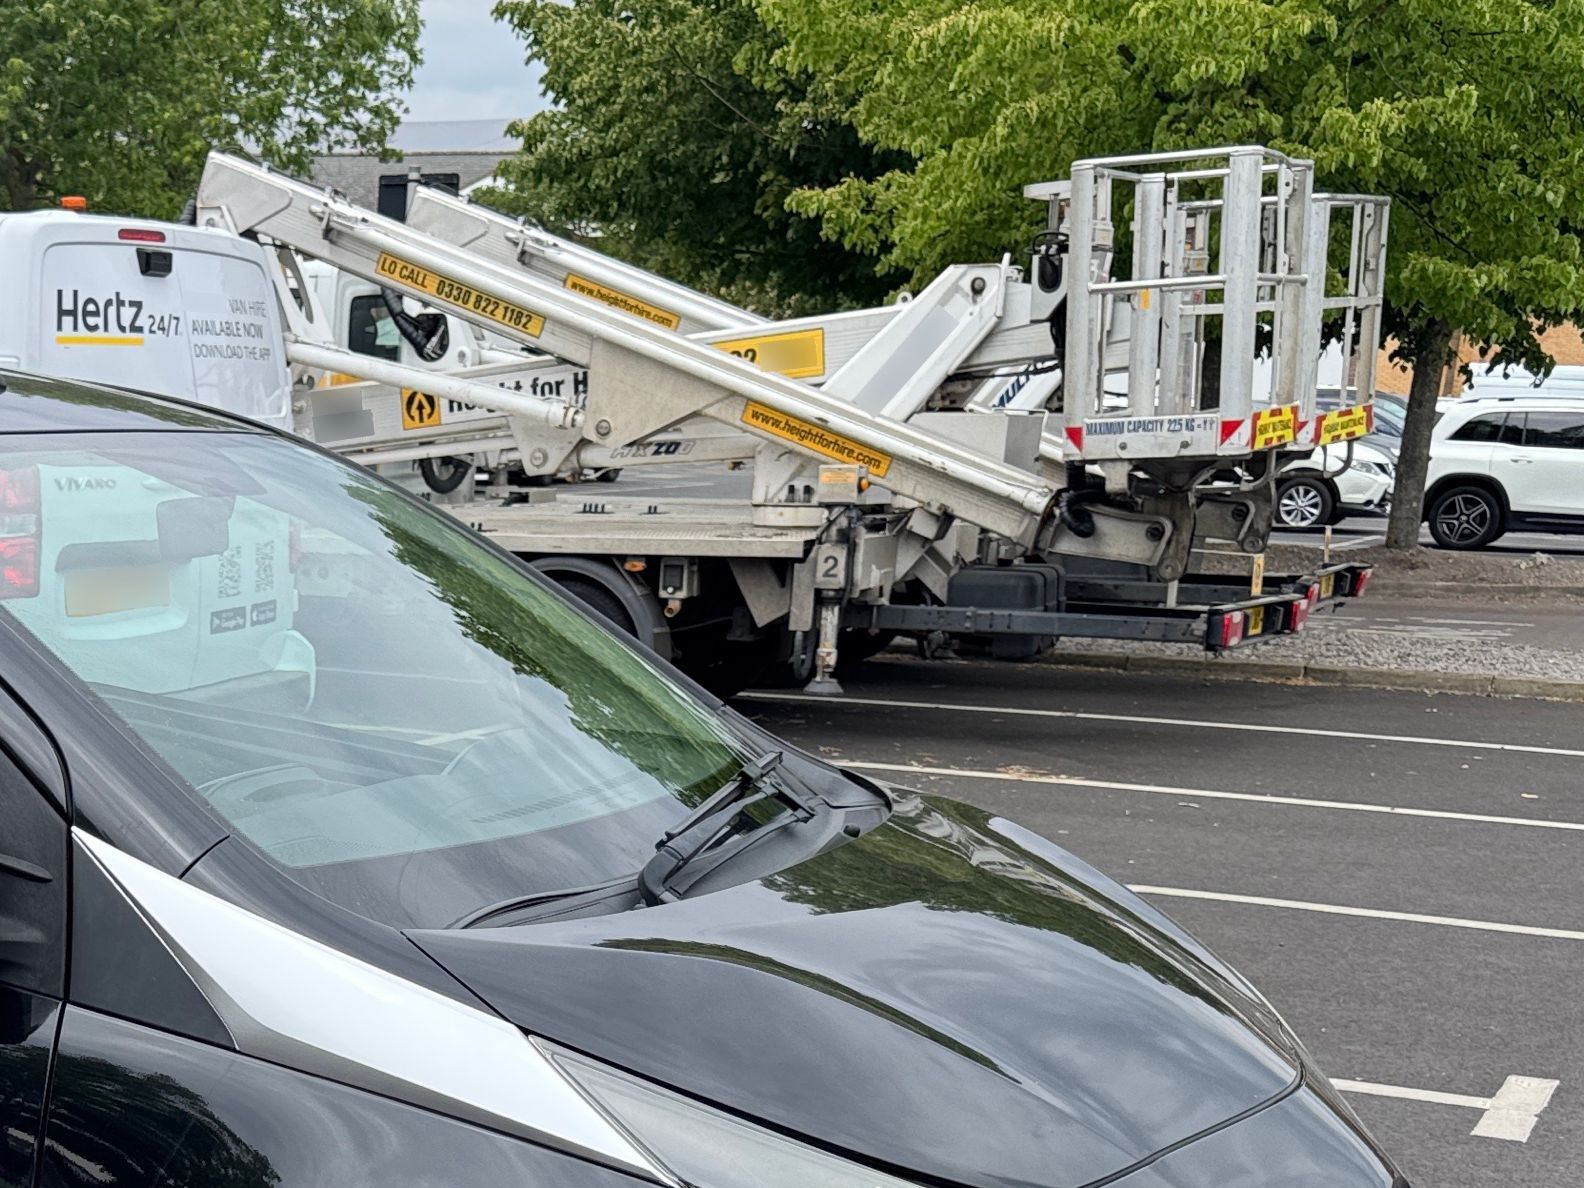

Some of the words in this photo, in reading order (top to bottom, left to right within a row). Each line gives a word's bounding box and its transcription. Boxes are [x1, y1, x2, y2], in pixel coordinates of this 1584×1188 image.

[381, 257, 397, 275] LO
[399, 265, 428, 289] CALL
[436, 279, 472, 306] 0330
[473, 294, 500, 318] 822
[502, 305, 533, 331] 1182
[56, 289, 144, 335] Hertz
[148, 314, 180, 338] 24/7
[191, 319, 242, 338] AVAILABLE
[243, 322, 264, 339] NOW
[193, 343, 244, 359] DOWNLOAD
[1127, 419, 1165, 434] CAPACITY
[1167, 418, 1184, 432] 225
[1185, 418, 1195, 432] KG
[751, 409, 883, 470] www.heightforhire.com
[822, 555, 839, 578] 2
